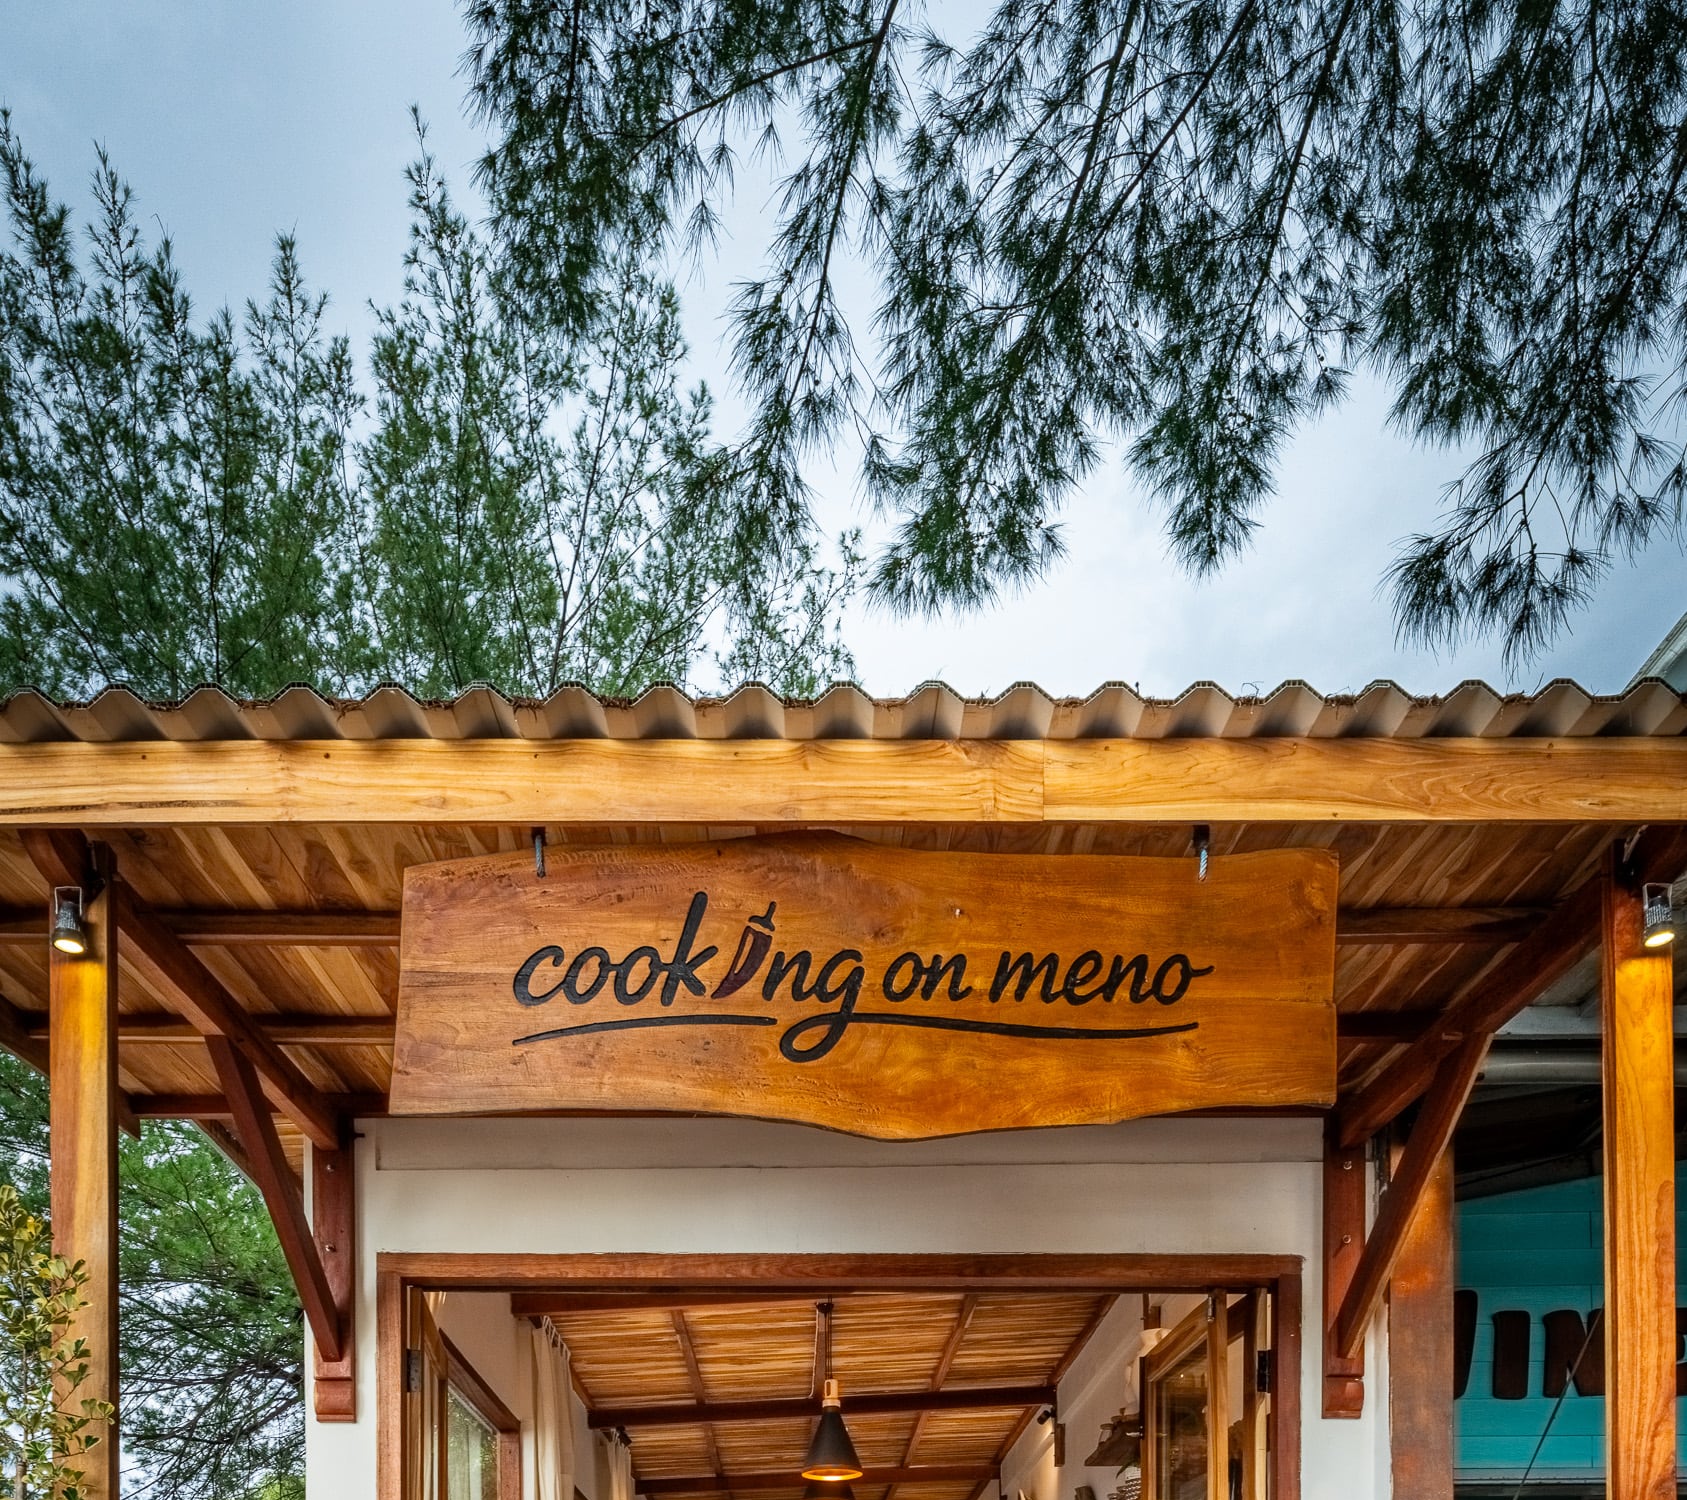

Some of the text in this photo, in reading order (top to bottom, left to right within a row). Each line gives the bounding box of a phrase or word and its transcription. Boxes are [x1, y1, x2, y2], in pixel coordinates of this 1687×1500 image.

[512, 890, 1215, 1064] cooking on meno
